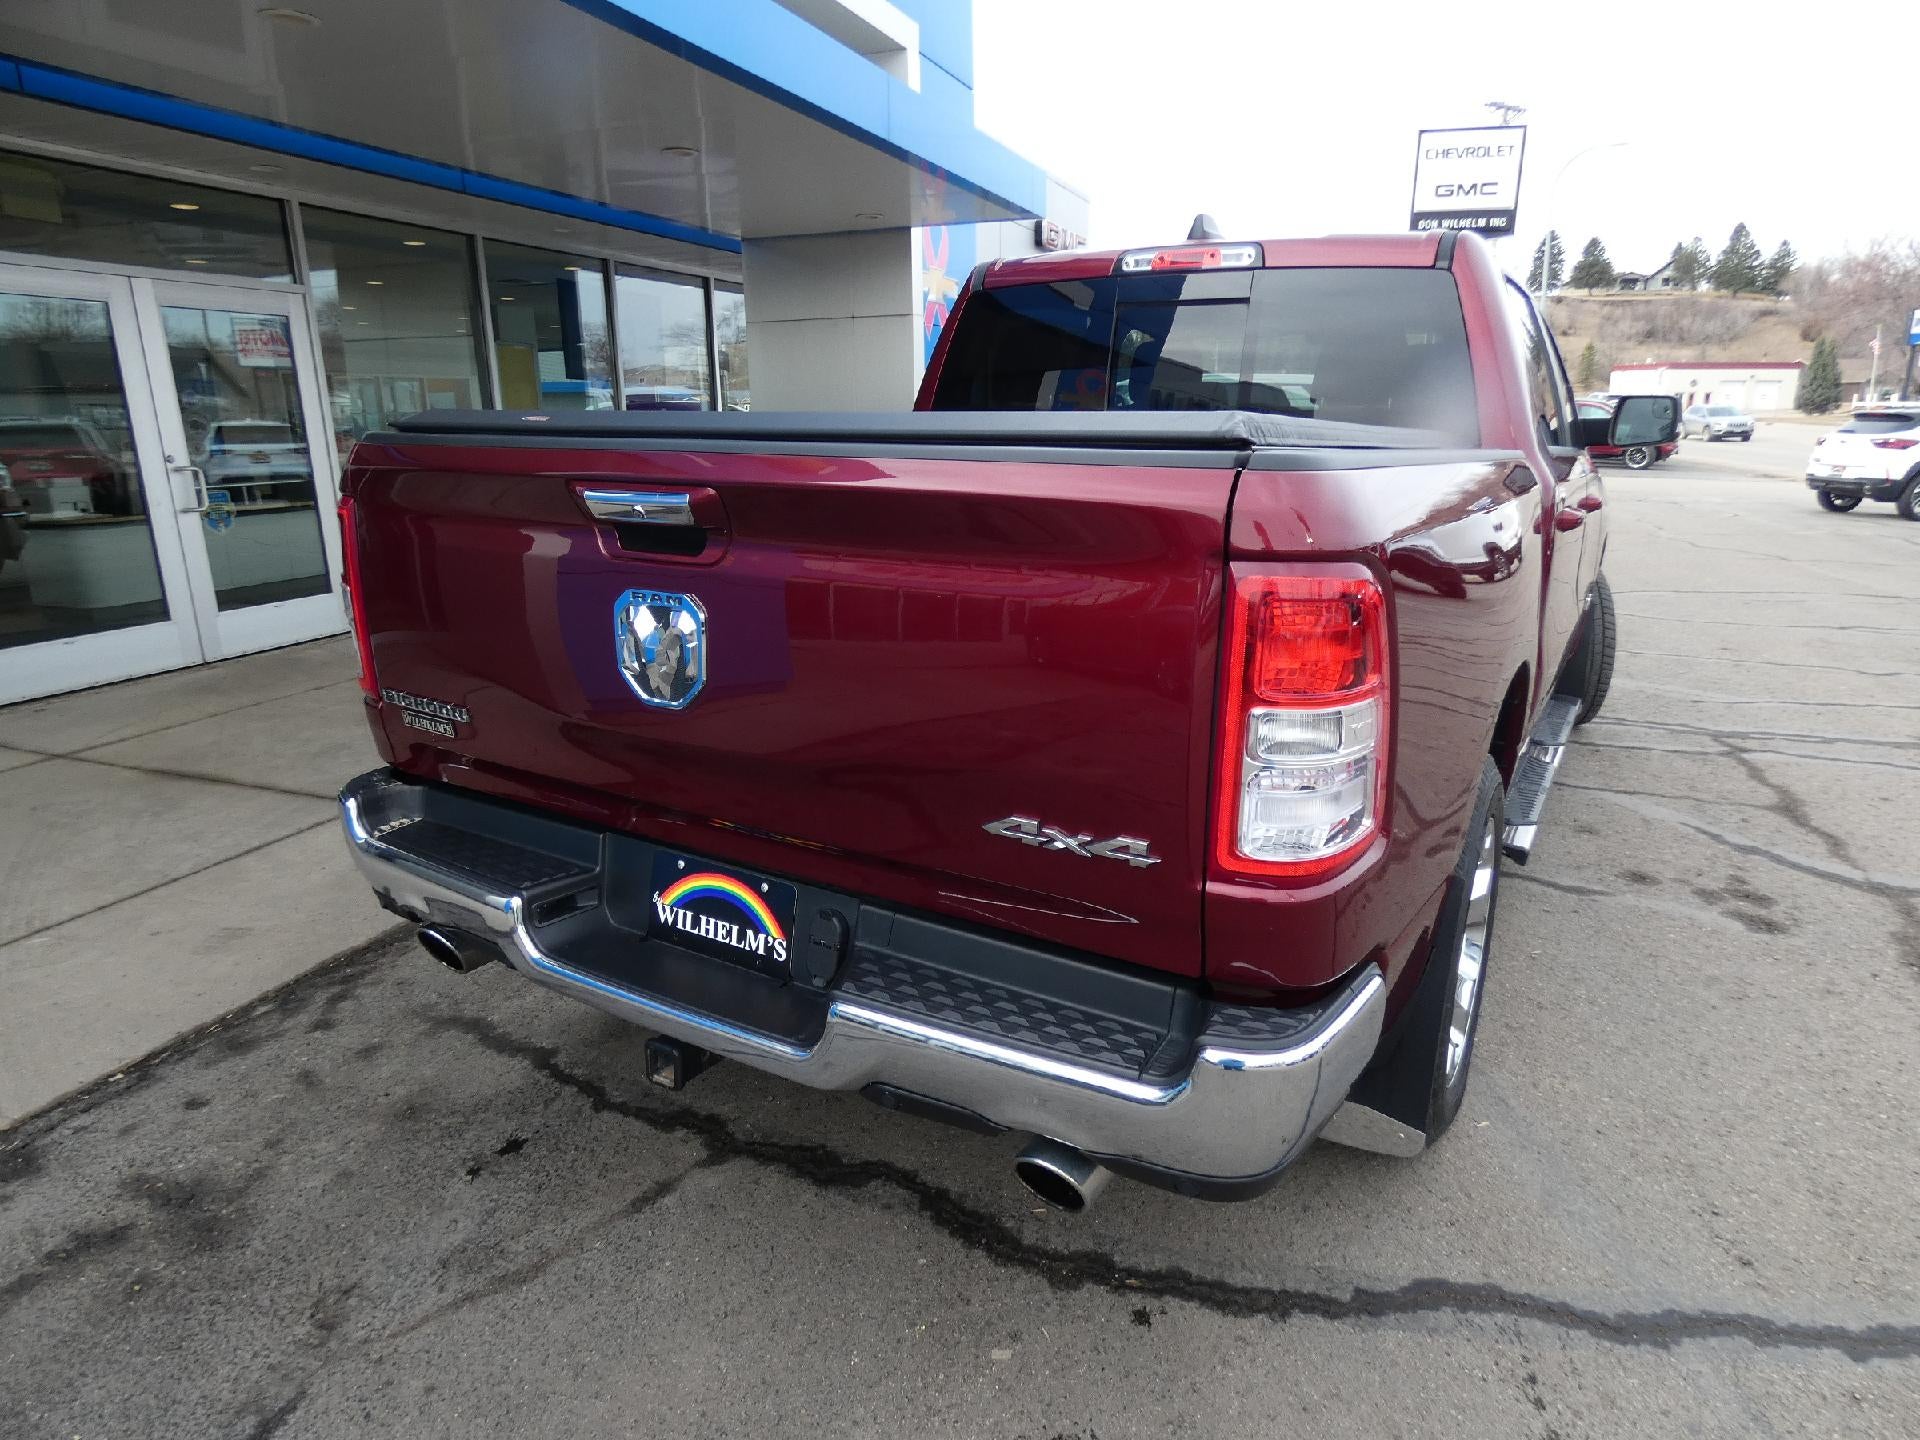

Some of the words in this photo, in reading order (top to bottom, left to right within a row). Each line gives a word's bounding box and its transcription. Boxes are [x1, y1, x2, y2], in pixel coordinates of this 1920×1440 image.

[1425, 145, 1515, 160] CHEVROLET
[1434, 182, 1498, 198] GMC
[1418, 219, 1439, 230] DON
[1442, 218, 1487, 229] WILHELM
[1489, 217, 1507, 227] INC
[631, 591, 683, 606] RAM
[404, 713, 454, 736] WILHELM'S
[656, 902, 788, 962] WILHELM'S
